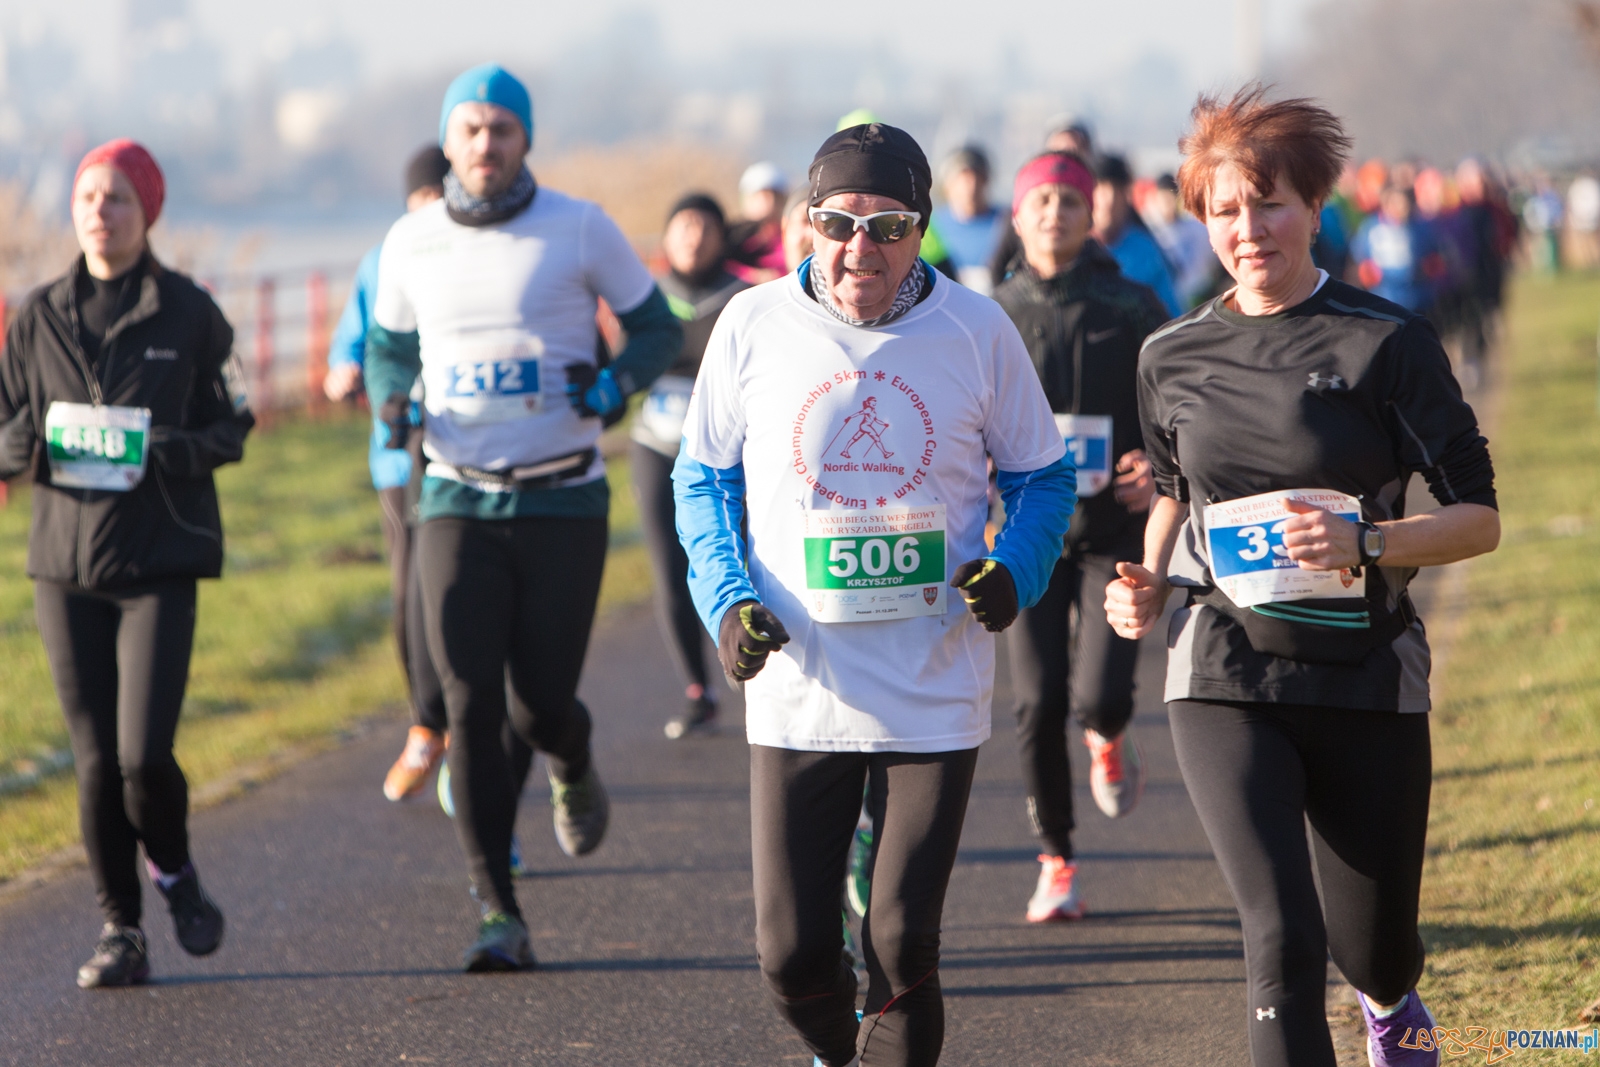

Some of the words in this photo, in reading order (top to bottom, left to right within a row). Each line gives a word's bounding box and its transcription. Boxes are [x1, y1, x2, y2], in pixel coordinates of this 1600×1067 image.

[455, 360, 523, 393] 212
[834, 369, 867, 385] 5km
[891, 375, 935, 435] European
[792, 380, 832, 475] Championship
[920, 439, 937, 467] Cup
[1068, 436, 1087, 466] 1
[823, 462, 859, 473] Nordic
[862, 462, 905, 475] Walking
[912, 467, 927, 485] 10
[805, 475, 867, 510] European
[893, 481, 916, 499] km
[1252, 501, 1274, 511] BIEG
[818, 516, 843, 525] XXXII
[845, 515, 867, 524] BIEG
[869, 511, 937, 523] SYLWESTROWY
[822, 527, 836, 535] IM.
[838, 524, 887, 534] RYSZARDA
[889, 521, 933, 532] BURGIELA
[1237, 518, 1289, 561] 33
[828, 536, 920, 578] 506
[1273, 559, 1298, 568] IREN
[847, 576, 905, 587] KRZYSZTOF
